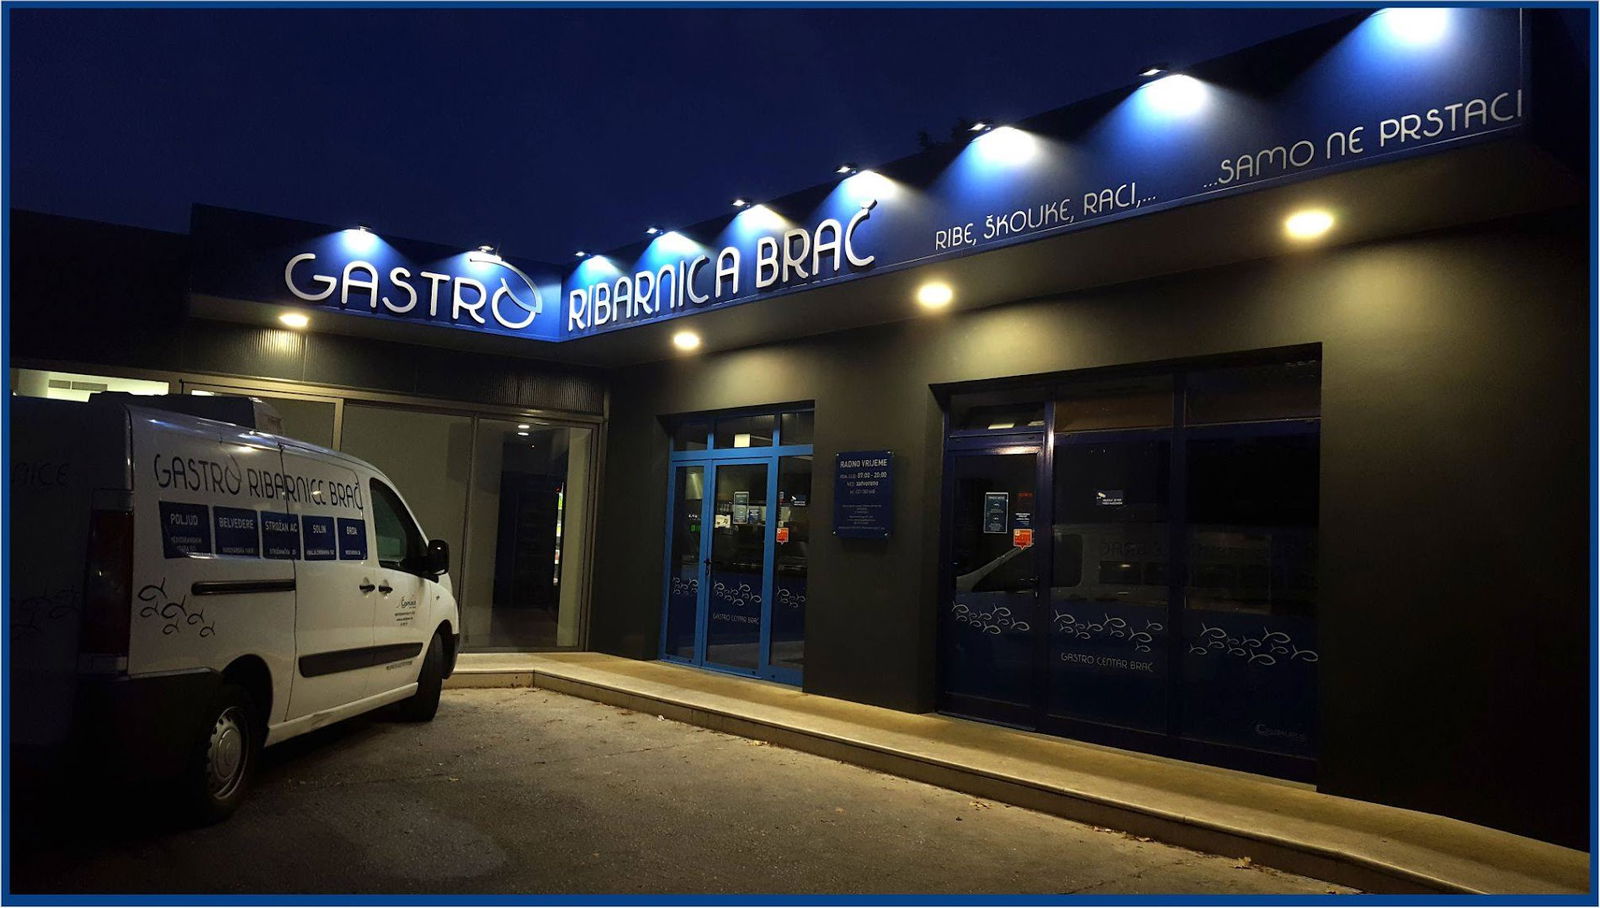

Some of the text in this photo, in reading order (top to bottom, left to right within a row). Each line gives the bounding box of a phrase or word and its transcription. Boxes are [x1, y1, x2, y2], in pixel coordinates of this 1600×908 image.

[1326, 126, 1364, 160] NE
[1379, 88, 1523, 147] PRSTACI
[935, 222, 977, 250] RIBE,
[567, 200, 877, 332] RIBARNICA BRAČ
[285, 252, 542, 329] GASTRO
[153, 453, 242, 496] GASTRO
[839, 458, 888, 469] RADNO VRIJEME
[169, 512, 199, 527] POLJUD
[217, 516, 255, 530] BELVEDERE
[312, 524, 327, 534] SOLIN
[1060, 652, 1095, 665] GASTRO
[1096, 656, 1128, 669] CENTAR
